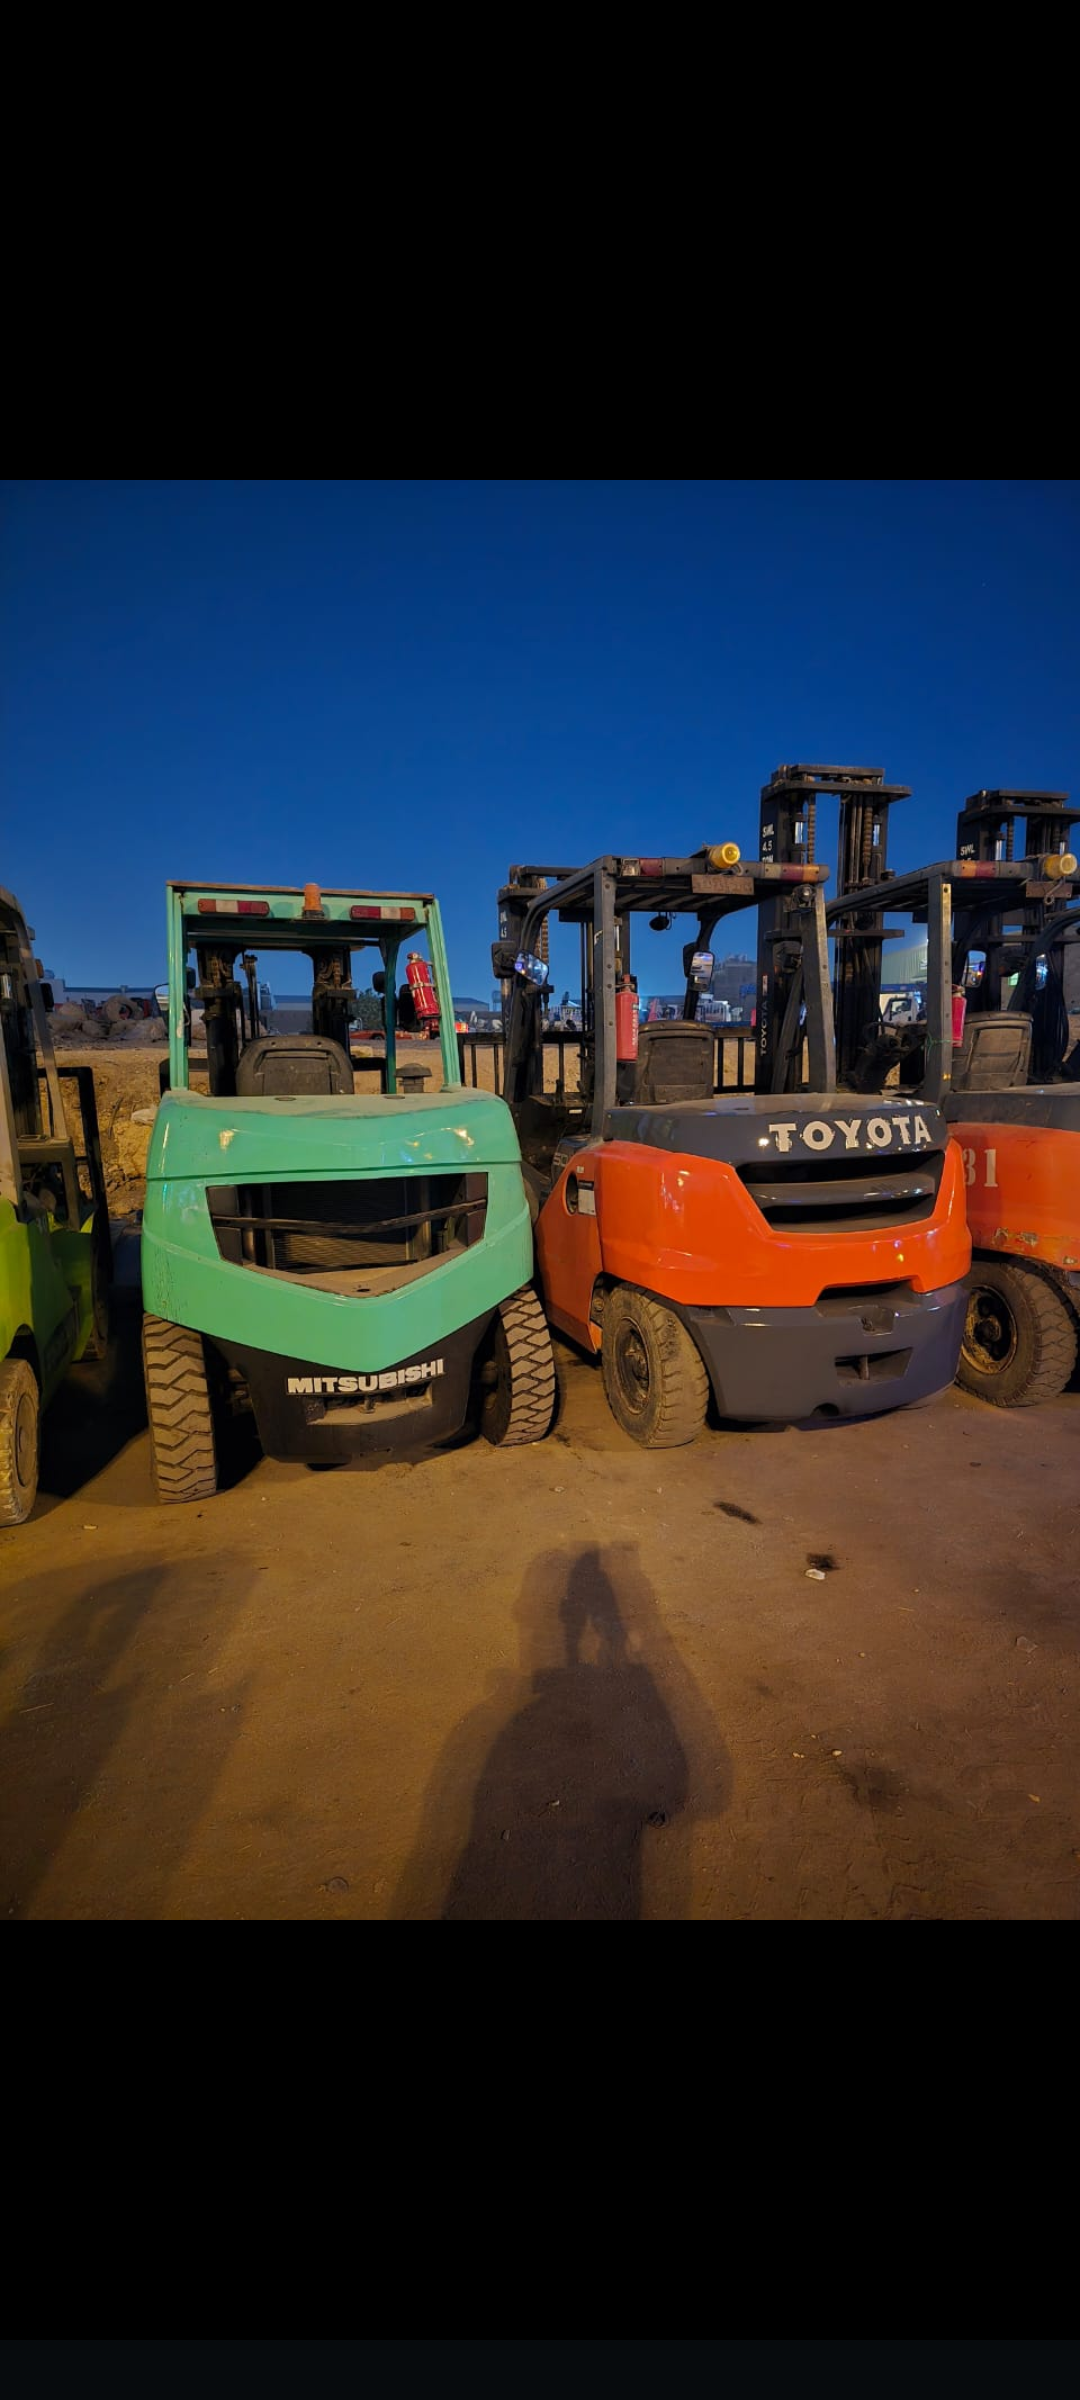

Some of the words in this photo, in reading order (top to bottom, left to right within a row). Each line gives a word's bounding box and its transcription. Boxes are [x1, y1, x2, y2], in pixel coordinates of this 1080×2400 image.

[960, 843, 976, 856] SWL
[760, 1000, 768, 1057] TOYOTA
[768, 1115, 932, 1153] TOYOTA
[287, 1358, 445, 1394] MITSUBISHI
